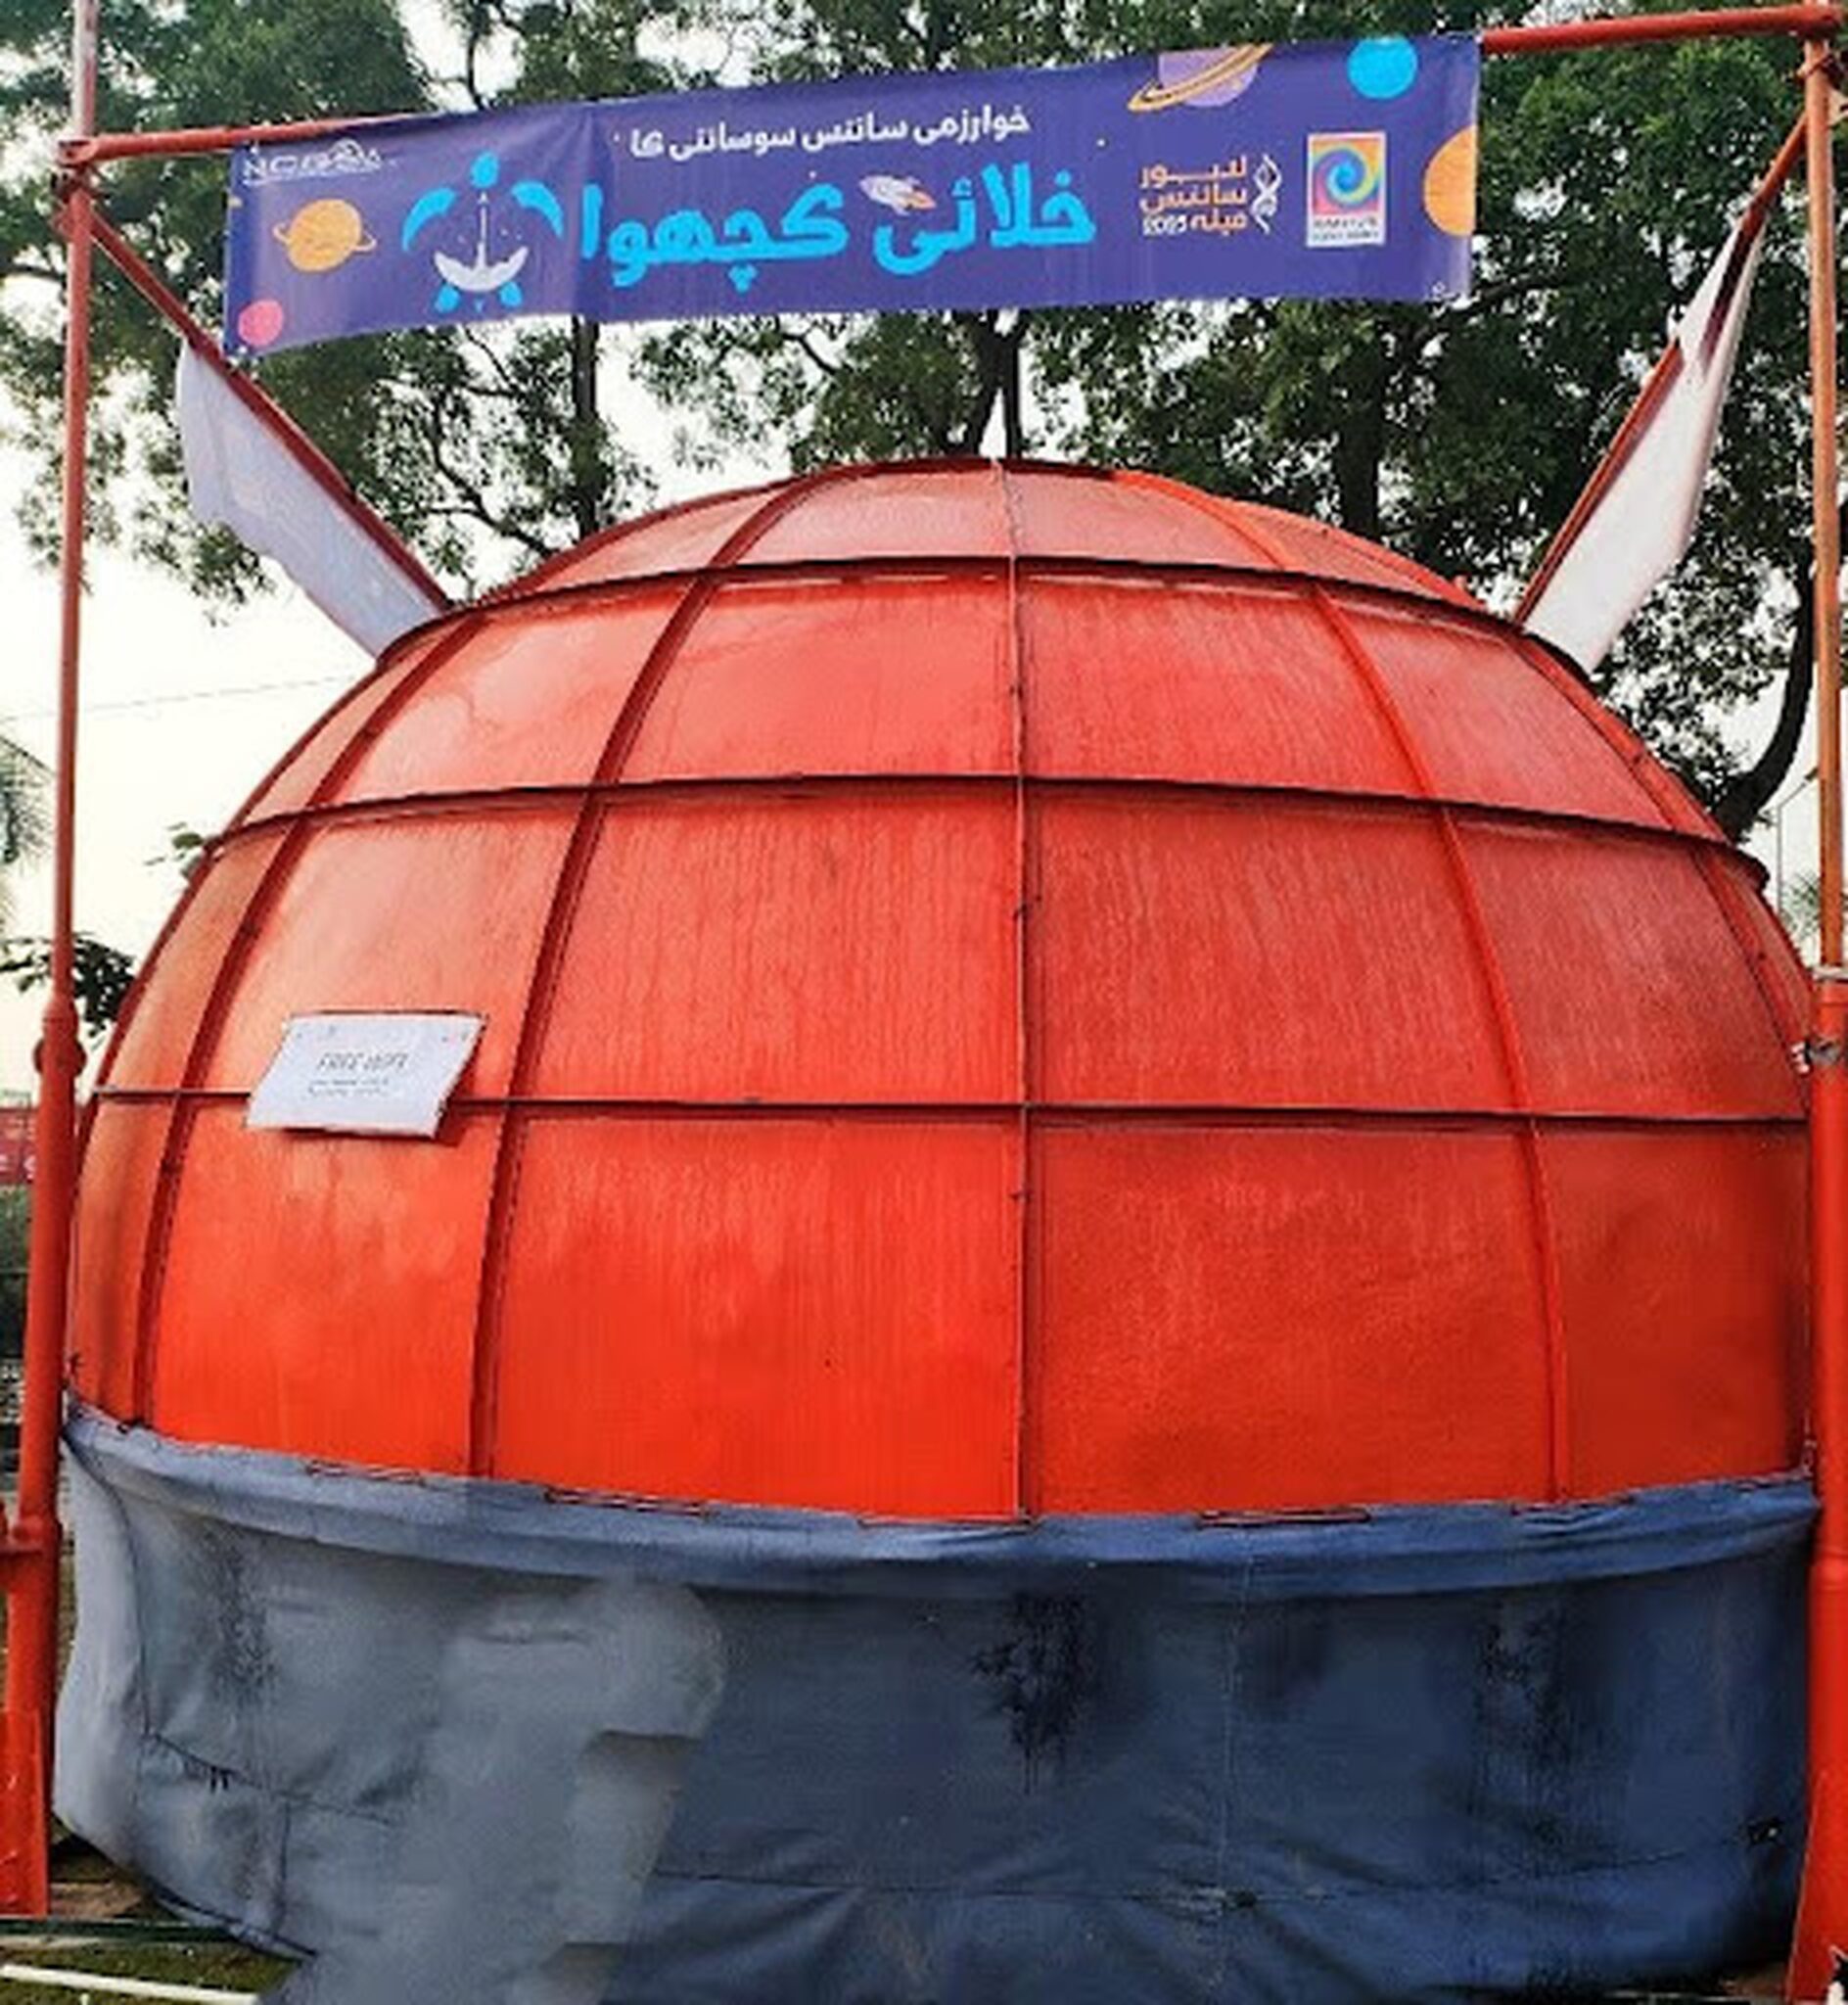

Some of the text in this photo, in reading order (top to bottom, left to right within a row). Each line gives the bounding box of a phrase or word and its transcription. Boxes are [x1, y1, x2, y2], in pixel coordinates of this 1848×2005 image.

[802, 111, 908, 153] سائنس
[912, 104, 1030, 147] خوارزمی
[581, 163, 1095, 292] خلائی کچھوا
